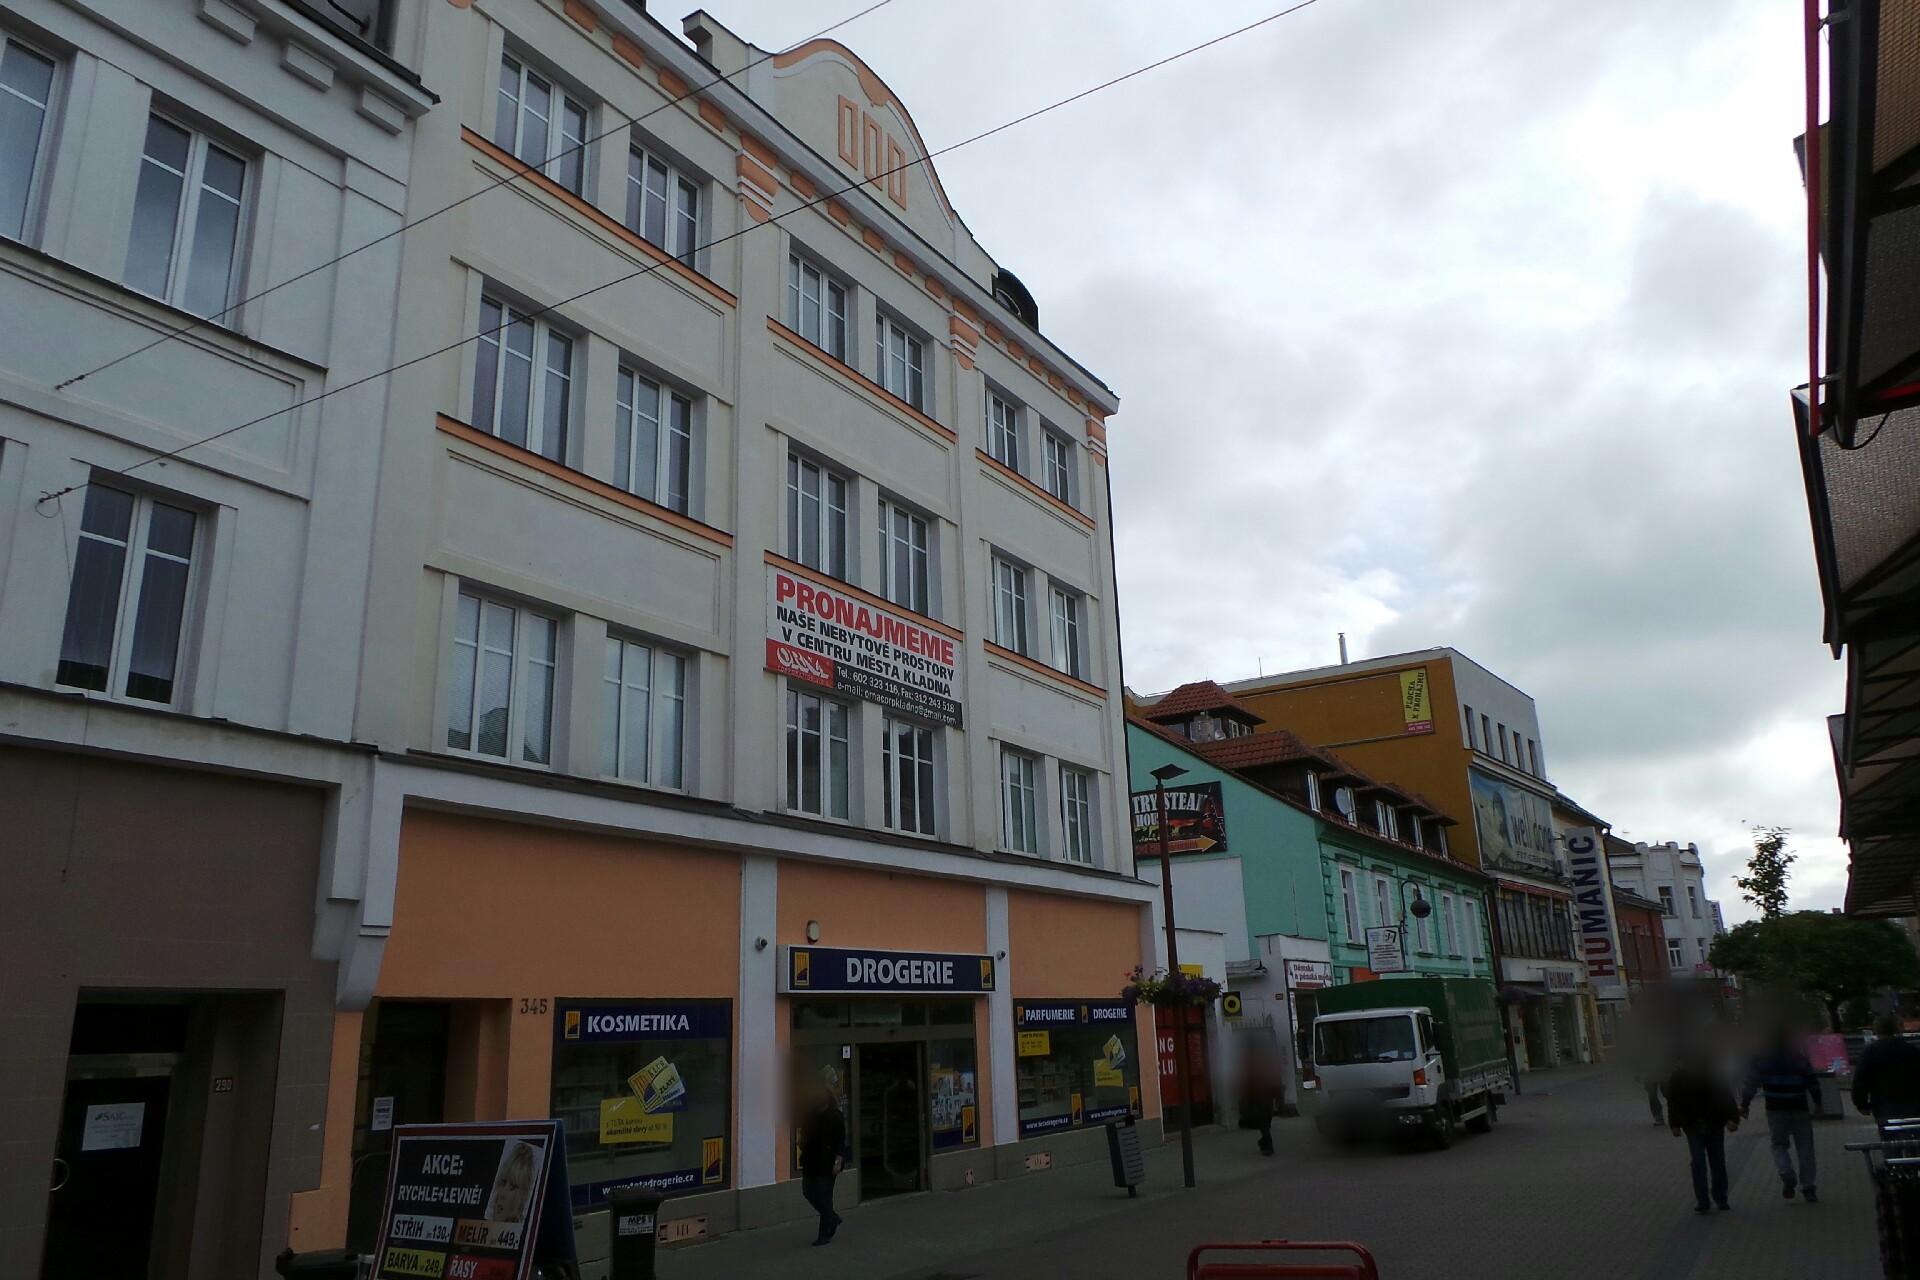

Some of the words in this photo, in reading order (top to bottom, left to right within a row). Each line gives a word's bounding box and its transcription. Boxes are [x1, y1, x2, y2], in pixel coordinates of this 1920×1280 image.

[776, 574, 954, 666] PRONAJMEME
[776, 605, 816, 632] NAŠE
[819, 622, 890, 657] NEBYTOVÉ
[893, 649, 954, 682] PROSTORY
[781, 626, 793, 642] V
[796, 632, 852, 663] CENTRU
[856, 652, 900, 680] MĚSTA
[903, 670, 952, 697] KLADNA
[837, 681, 863, 697] e-mail:
[837, 666, 852, 680] Tel.:
[852, 671, 868, 685] 602
[869, 676, 883, 689] 323
[914, 692, 928, 705] 312
[928, 697, 941, 709] 243
[942, 702, 955, 713] 518
[1568, 836, 1616, 977] HUMANIC
[846, 957, 954, 984] DROGERIE
[520, 998, 547, 1014] 345
[1025, 1008, 1075, 1021] PARFUMERIE
[1093, 1007, 1128, 1019] DROGERIE
[587, 1014, 690, 1033] KOSMETIKA
[215, 1079, 232, 1091] 290
[421, 1154, 464, 1176] AKCE:
[397, 1184, 483, 1206] RYCHLE+LEVNĚ!
[394, 1216, 424, 1237] STŘIH
[458, 1222, 489, 1244] MELÍR
[387, 1252, 419, 1268] BARVA
